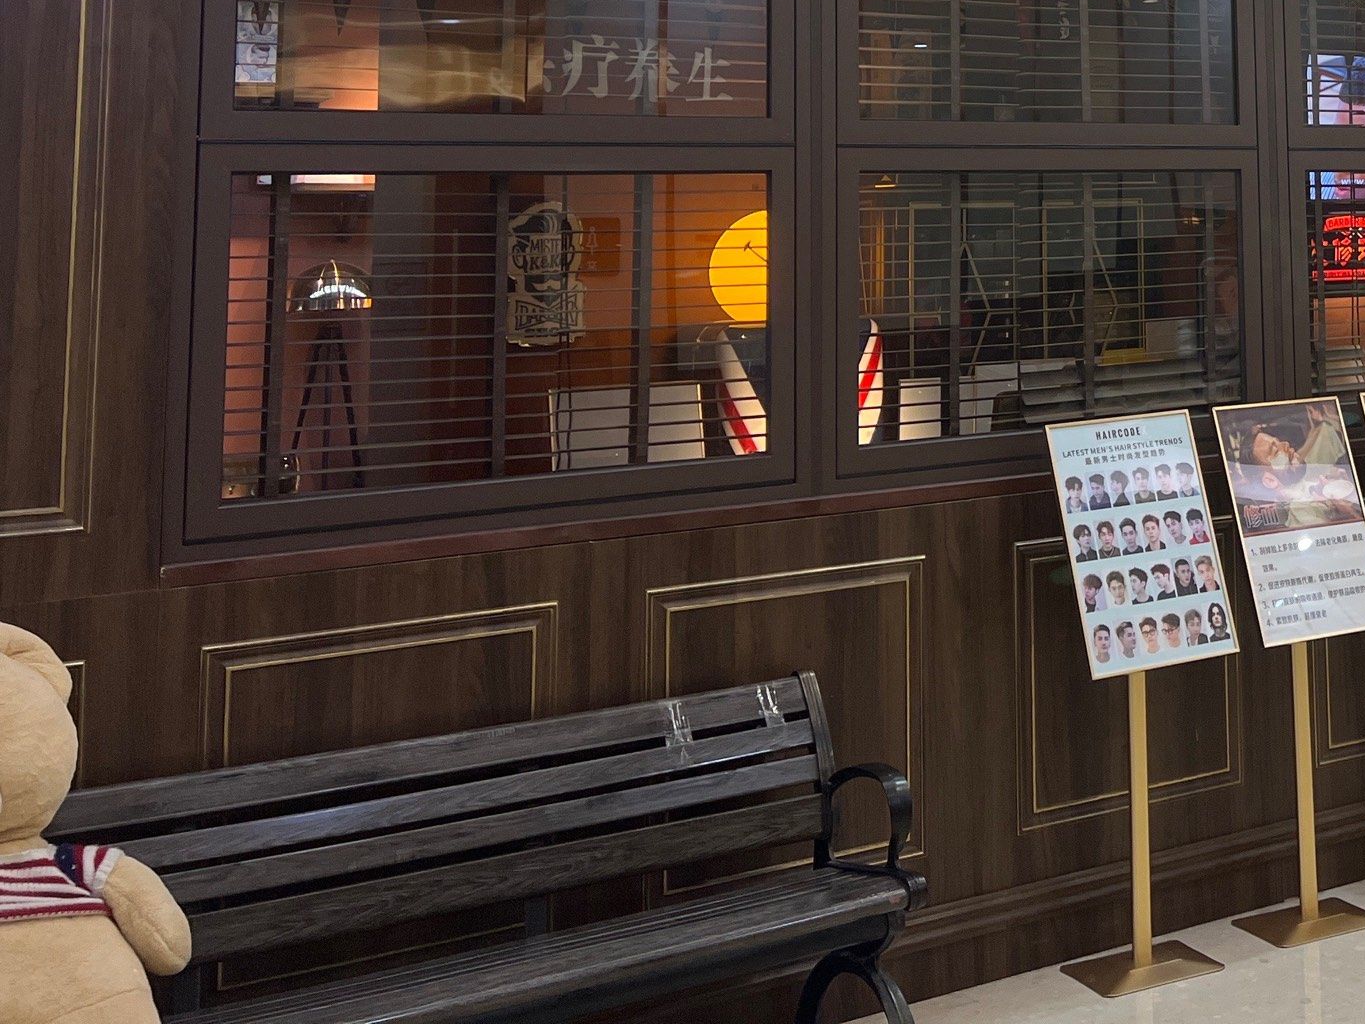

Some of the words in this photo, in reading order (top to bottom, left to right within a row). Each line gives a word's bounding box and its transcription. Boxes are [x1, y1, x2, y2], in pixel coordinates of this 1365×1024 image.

[1095, 426, 1141, 440] HAIRCODE
[1062, 448, 1089, 458] LATEST
[1115, 442, 1132, 452] HAIR
[1132, 439, 1154, 450] STYLE
[1154, 436, 1183, 448] TRENDS
[1085, 449, 1166, 465] 最新男士时尚发型趋势
